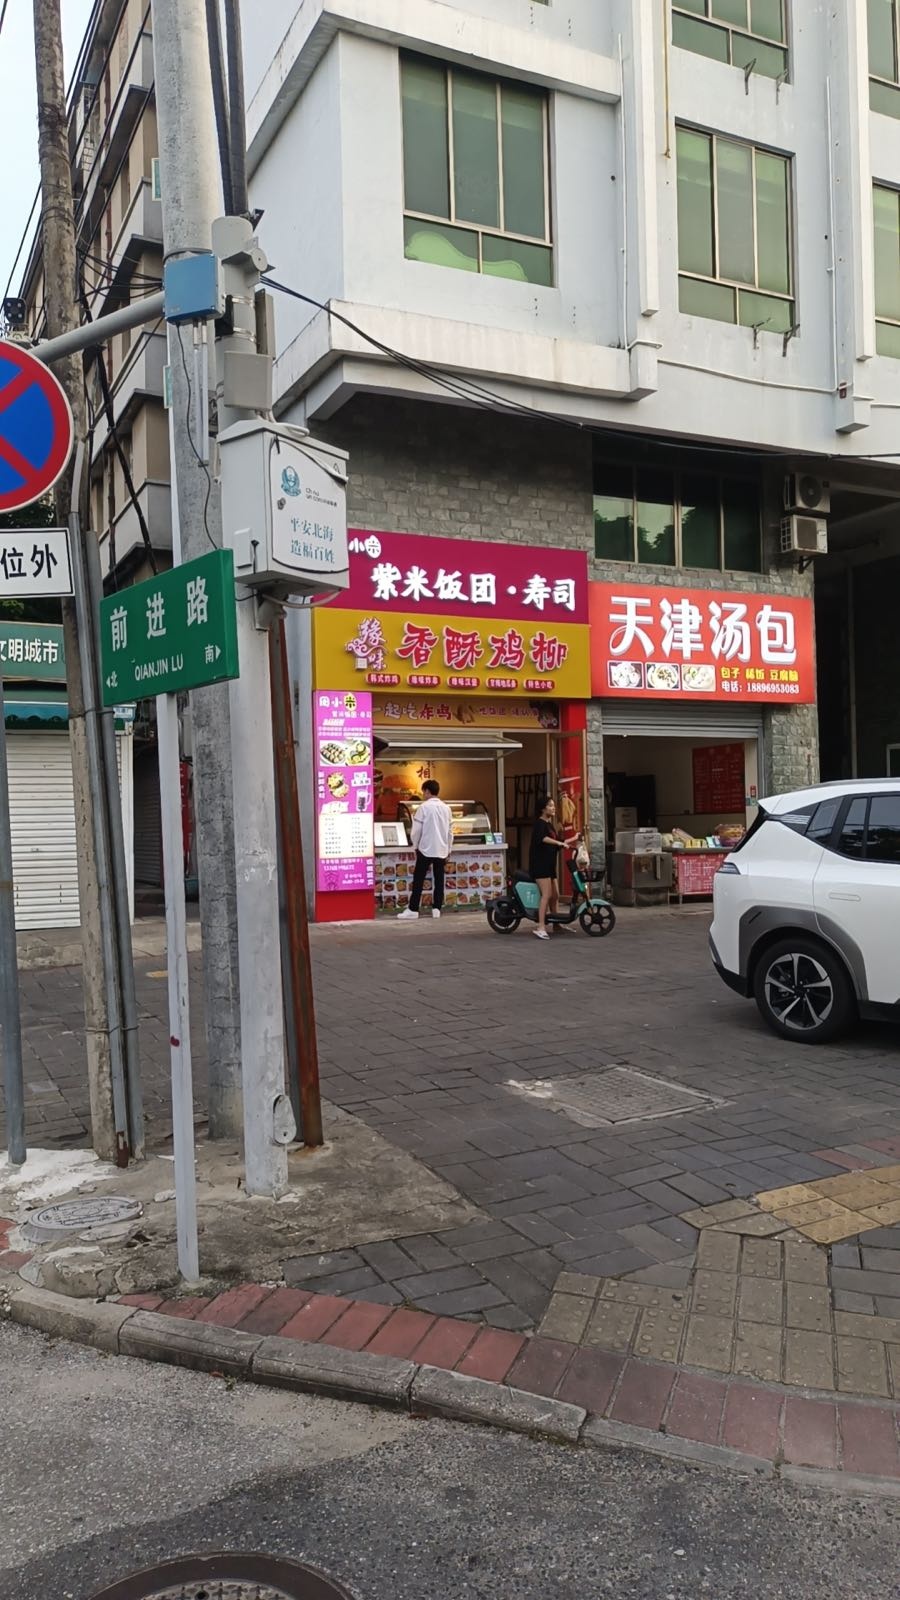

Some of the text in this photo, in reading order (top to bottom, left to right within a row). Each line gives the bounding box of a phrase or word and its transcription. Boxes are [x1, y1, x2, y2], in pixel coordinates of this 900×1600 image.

[290, 517, 334, 542] 平安北海
[0, 543, 58, 579] 位外
[290, 540, 335, 564] 造福百姓
[109, 576, 209, 652] 前进路
[607, 595, 798, 666] 天津汤包
[204, 643, 215, 665] 南
[396, 621, 569, 673] 香酥鸡柳
[134, 653, 184, 681] QIANJIN LU
[721, 666, 740, 679] 包子
[110, 671, 119, 689] 北
[528, 680, 553, 690] 特色小吃
[746, 682, 800, 694] 18896953083
